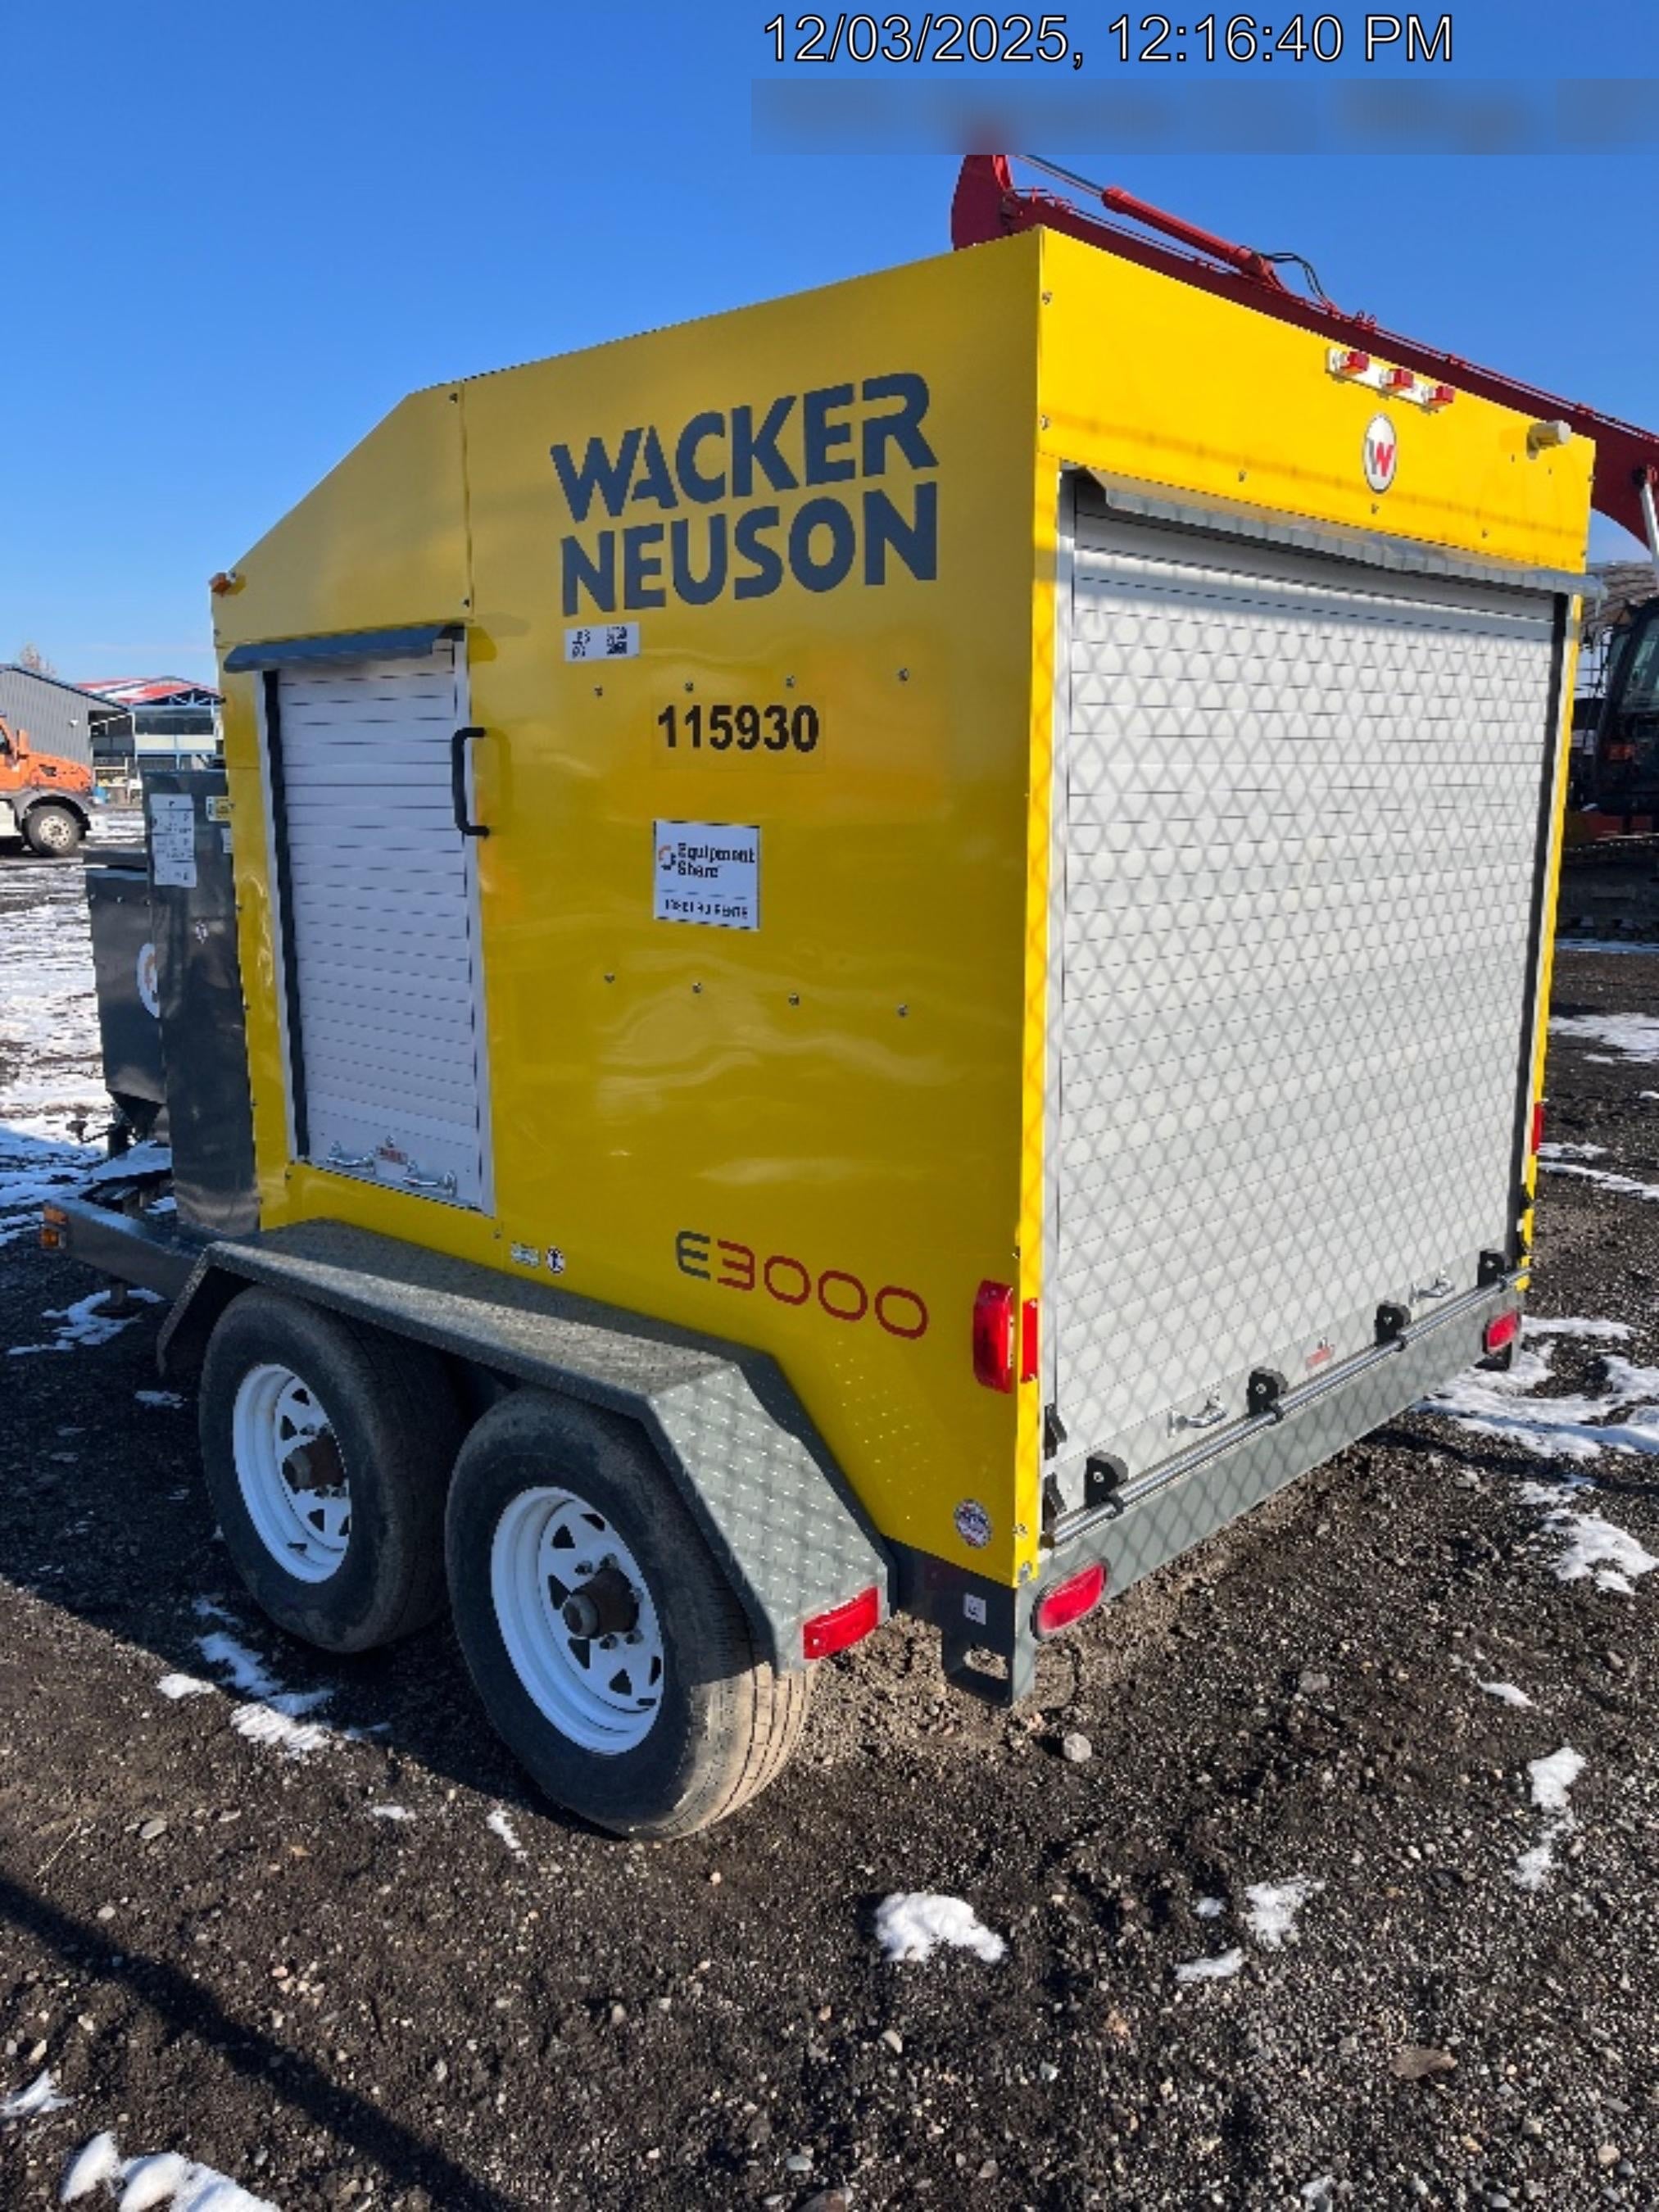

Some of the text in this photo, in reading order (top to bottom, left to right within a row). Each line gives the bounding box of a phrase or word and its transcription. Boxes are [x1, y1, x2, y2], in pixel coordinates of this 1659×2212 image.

[551, 373, 941, 524] WACKER
[561, 481, 938, 618] NEUSON
[658, 704, 820, 754] 115930
[678, 842, 755, 863] Equipment
[675, 1230, 930, 1340] E3000
